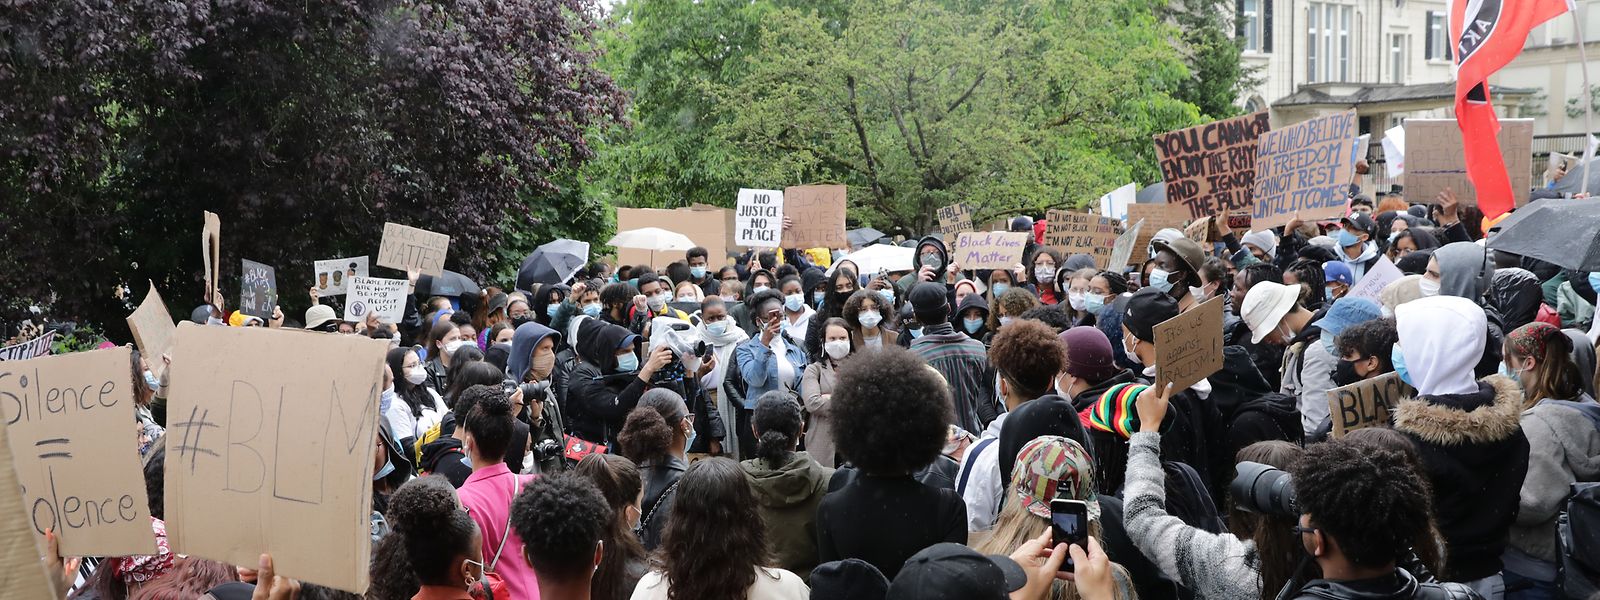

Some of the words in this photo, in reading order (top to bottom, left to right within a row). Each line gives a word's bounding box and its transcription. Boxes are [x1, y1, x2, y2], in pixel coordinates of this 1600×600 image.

[1154, 127, 1200, 158] YOU
[1202, 112, 1270, 151] CANNOT
[1257, 131, 1278, 158] WE
[1278, 124, 1306, 153] WHO
[1304, 112, 1355, 148] BELIEVE
[1160, 151, 1208, 183] ENJOY
[1205, 151, 1229, 176] THE
[1226, 143, 1258, 172] RHY
[1256, 158, 1271, 180] IN
[1273, 142, 1342, 175] FREEDOM
[1167, 180, 1199, 204] AND
[1207, 169, 1256, 194] IGNOR
[1253, 172, 1295, 199] CANNOT
[1297, 164, 1342, 189] REST
[738, 205, 778, 217] JUSTICE
[753, 193, 770, 205] NO
[789, 190, 843, 208] BLACK
[939, 202, 969, 221] #BLM
[1181, 194, 1216, 219] THE
[1214, 188, 1254, 212] BLUE
[1252, 192, 1287, 219] UNTIL
[1290, 189, 1308, 212] IT
[1305, 183, 1348, 210] COMES
[742, 229, 776, 242] PEACE
[750, 217, 767, 229] NO
[783, 228, 843, 242] MATTER
[378, 238, 441, 273] MATTER
[960, 234, 993, 248] Black
[995, 235, 1021, 247] Lives
[1061, 236, 1074, 246] NOT
[1075, 235, 1093, 247] BLACK
[965, 251, 1014, 264] Matter
[375, 304, 397, 312] US!!
[0, 368, 118, 425] Silence
[172, 379, 378, 526] #BLM
[30, 466, 137, 537] olence
